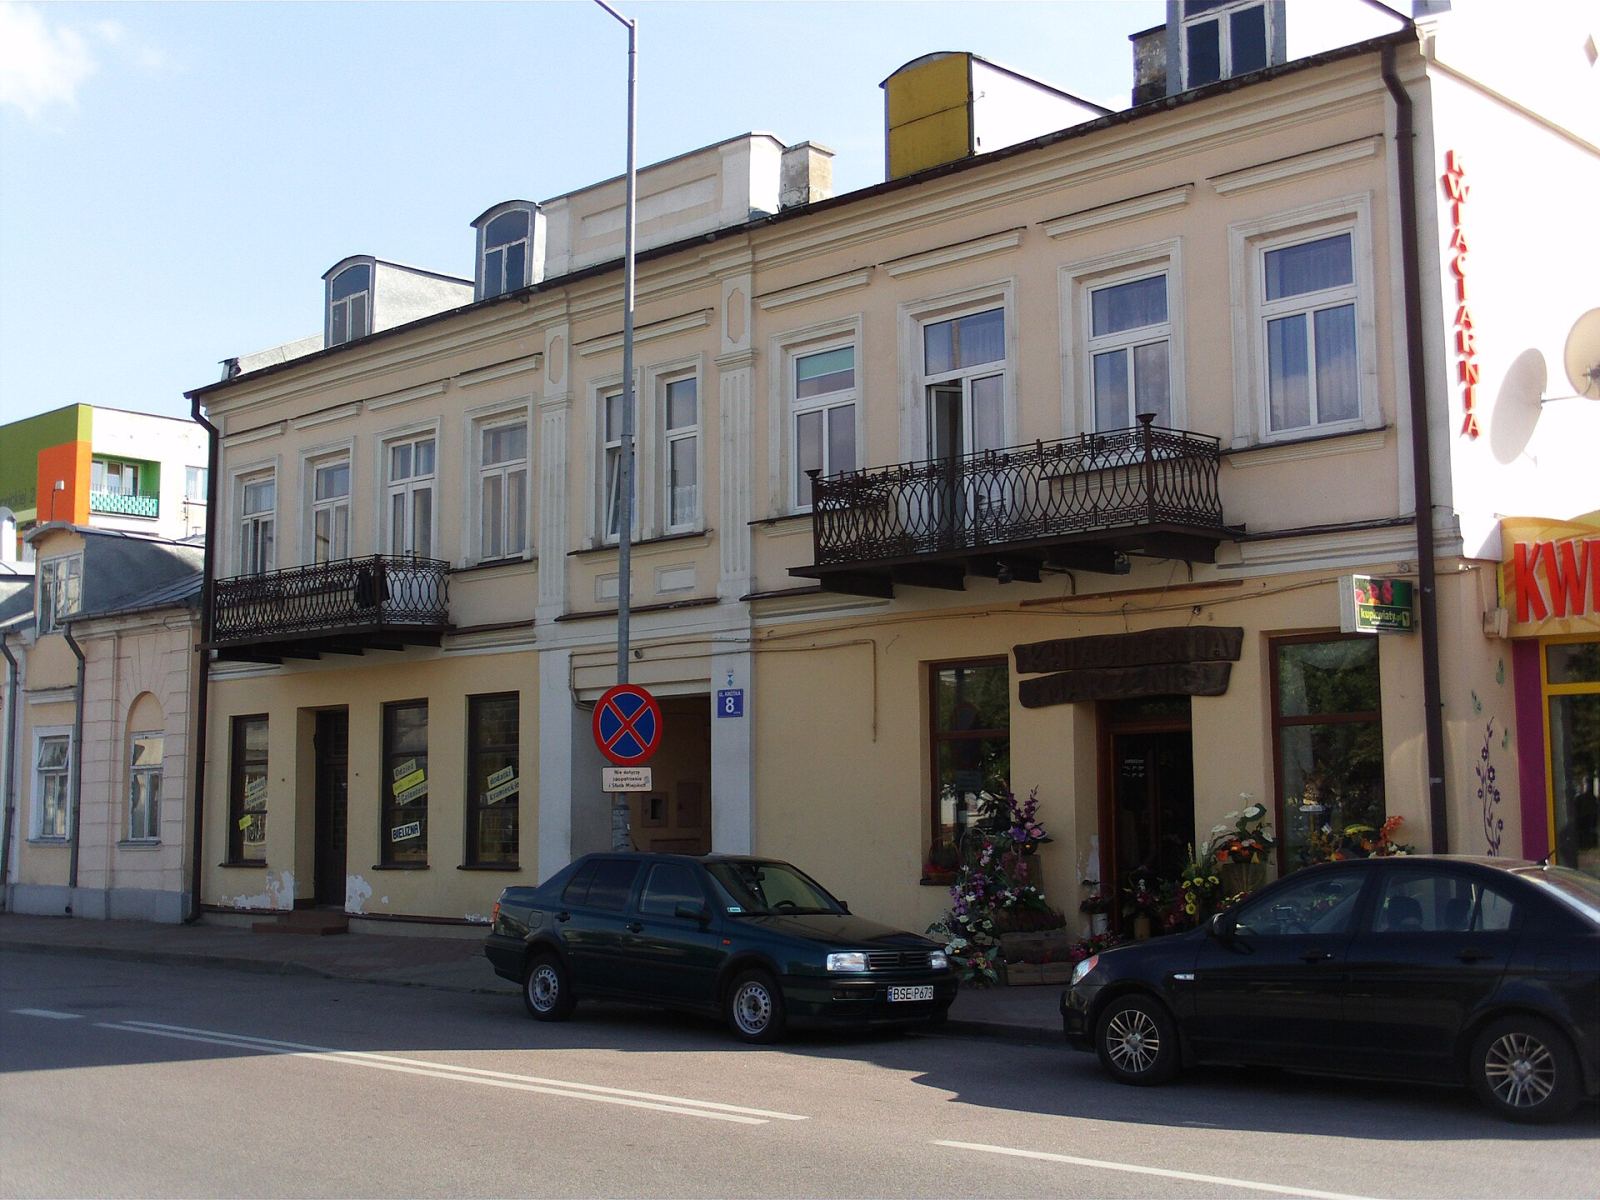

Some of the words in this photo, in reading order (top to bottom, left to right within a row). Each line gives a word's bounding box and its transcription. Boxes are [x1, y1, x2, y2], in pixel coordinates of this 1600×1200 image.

[1441, 149, 1481, 440] KWIACIARNIA
[725, 696, 735, 713] 8
[393, 824, 419, 841] BIELIZNA
[893, 987, 912, 1000] BSE
[914, 986, 933, 999] P673
